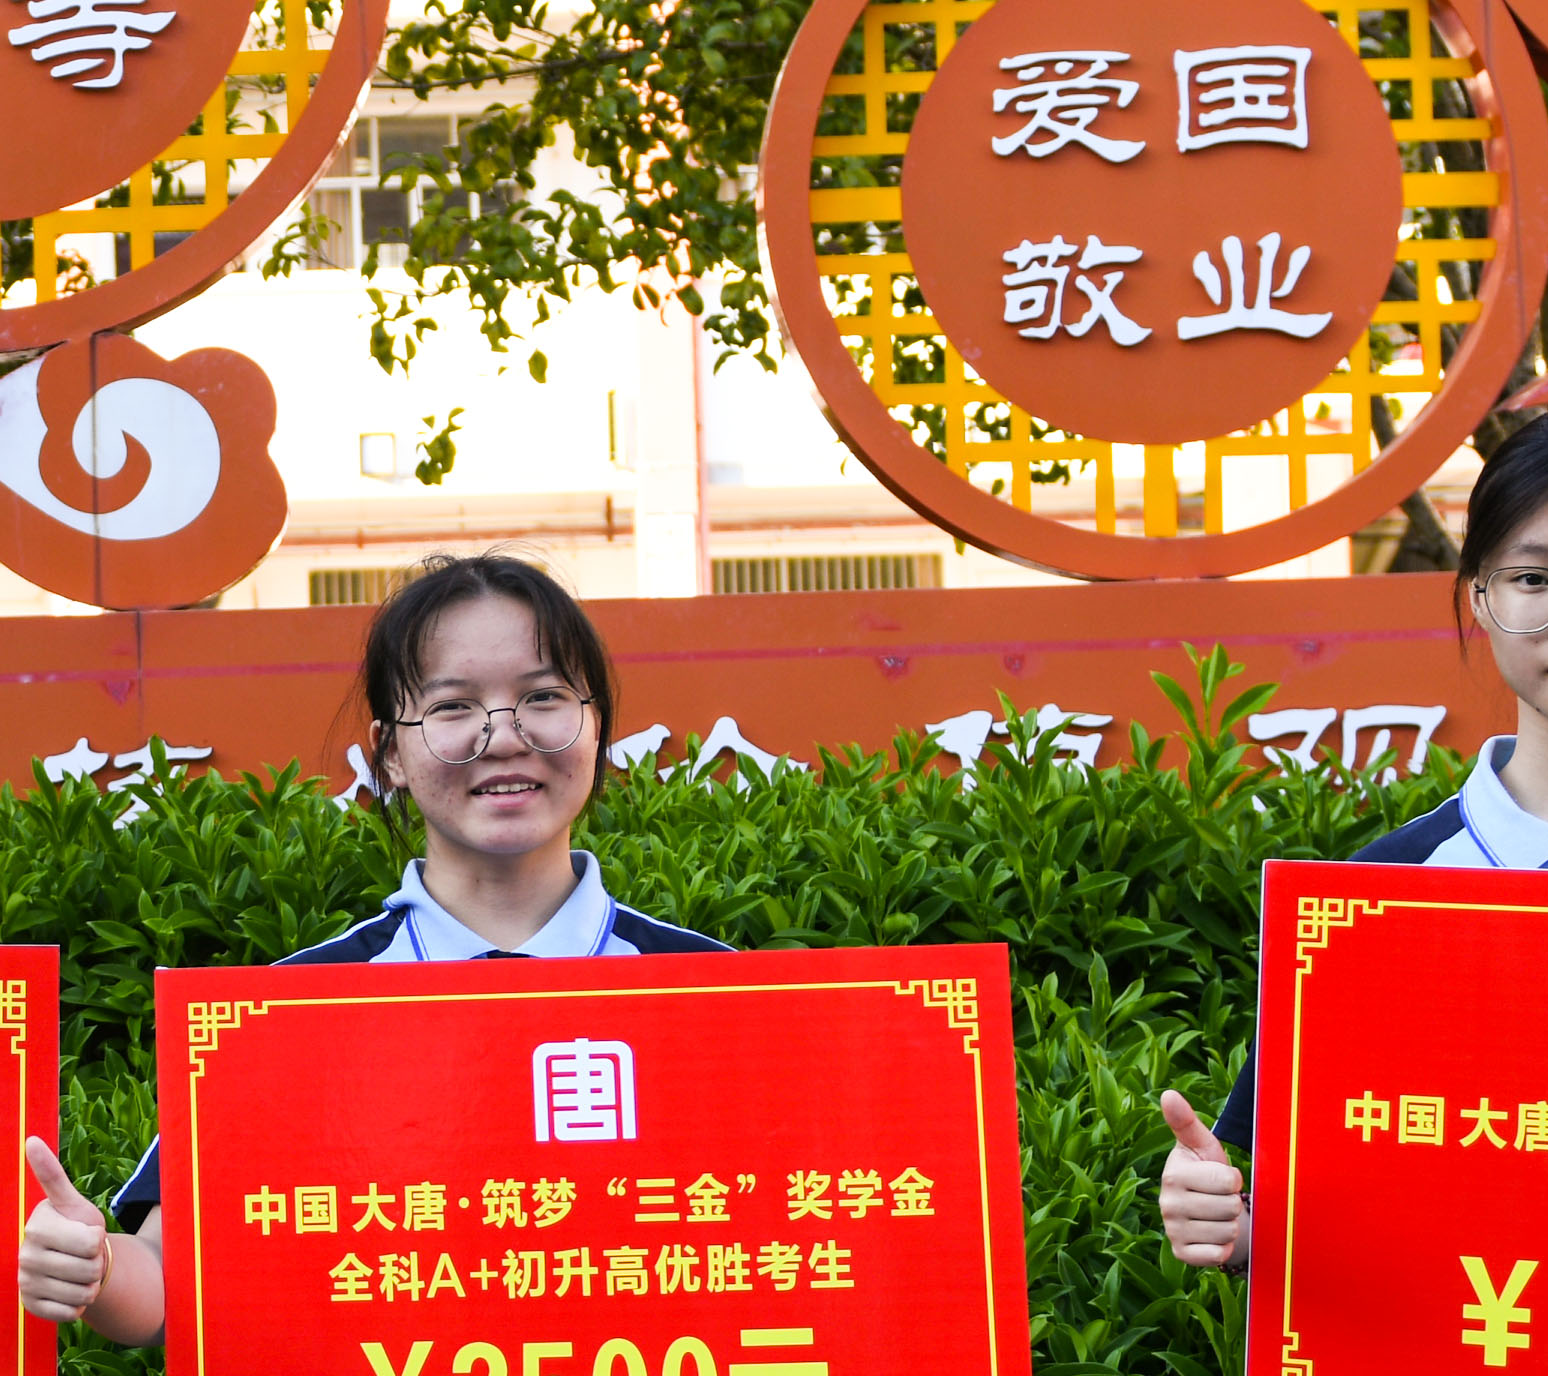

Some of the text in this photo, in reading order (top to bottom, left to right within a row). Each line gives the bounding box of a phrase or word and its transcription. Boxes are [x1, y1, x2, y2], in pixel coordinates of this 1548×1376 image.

[991, 44, 1312, 162] 爱国
[1002, 232, 1333, 346] 敬业
[532, 1037, 637, 1142] 唐
[328, 1239, 855, 1303] 全科A+初升高优胜考生
